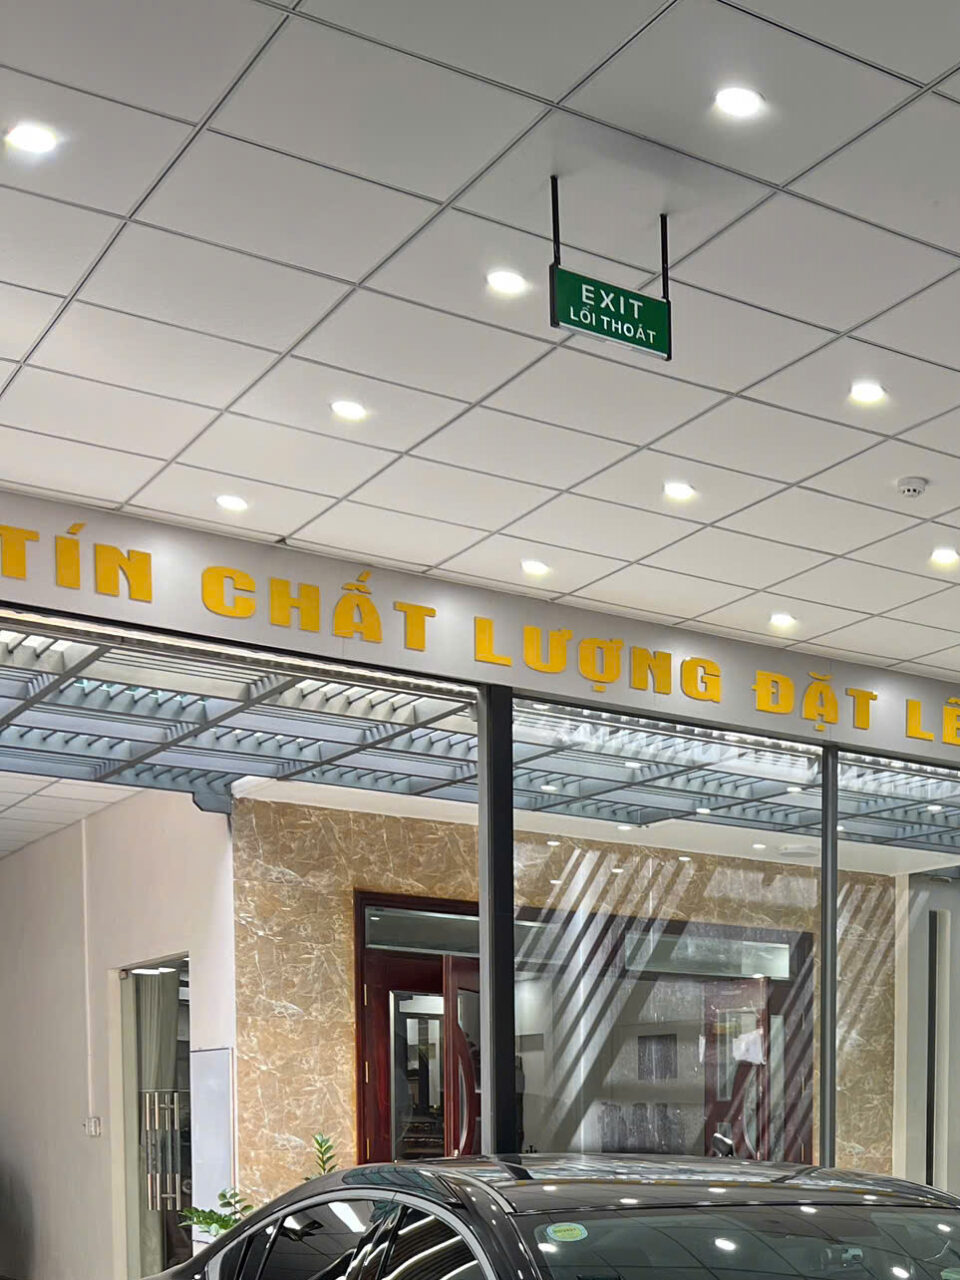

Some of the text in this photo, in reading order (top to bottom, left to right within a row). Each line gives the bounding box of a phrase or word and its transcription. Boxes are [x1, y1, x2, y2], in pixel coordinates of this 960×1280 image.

[582, 283, 643, 319] EXIT
[570, 305, 657, 344] LỐI THOÁT
[0, 523, 153, 602] TÍN
[201, 565, 437, 651] CHẤT
[474, 617, 722, 703] LƯỢNG
[751, 669, 878, 732] ĐẶT
